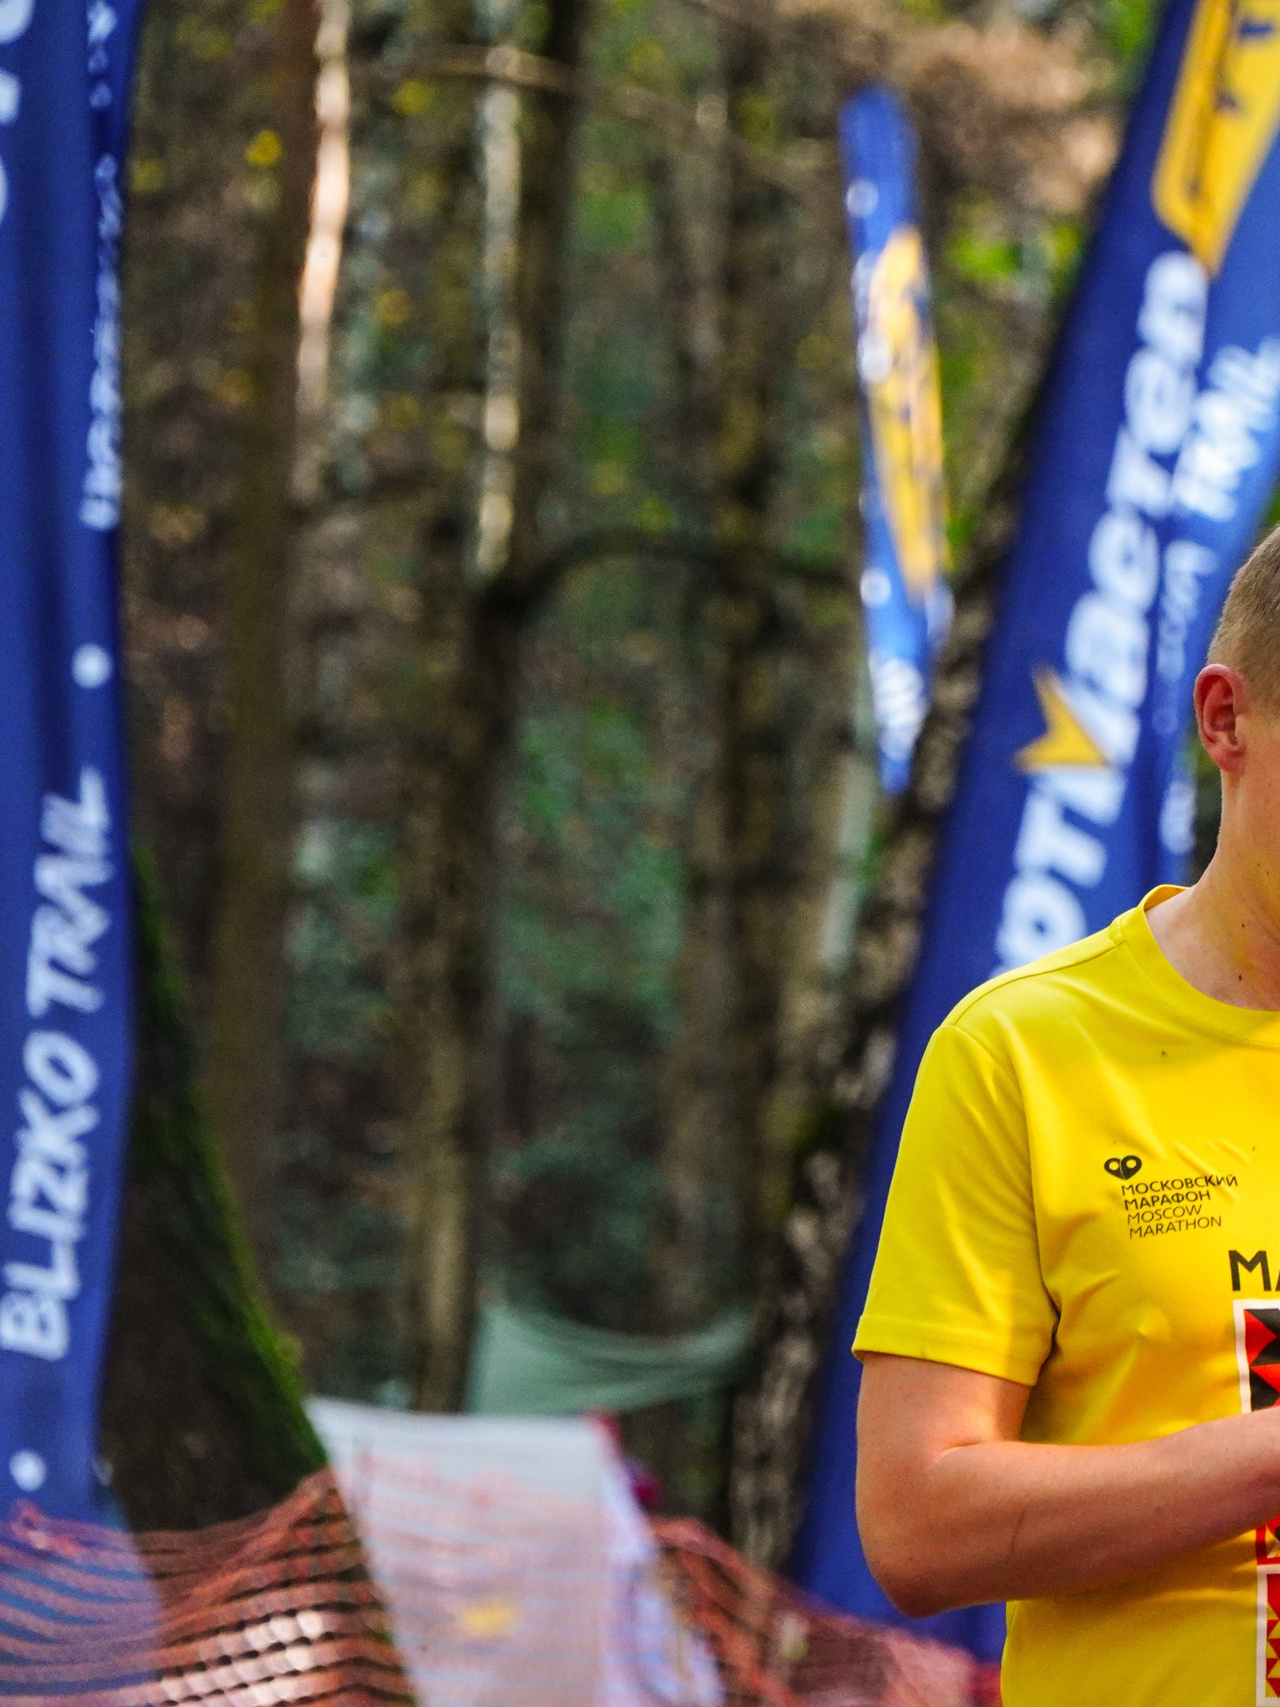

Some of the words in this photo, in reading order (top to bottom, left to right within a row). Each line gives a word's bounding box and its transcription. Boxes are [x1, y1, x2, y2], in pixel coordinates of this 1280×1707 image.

[27, 766, 114, 1016] TRAIL
[0, 1030, 98, 1361] BLIZKO
[1121, 1174, 1238, 1196] МОСКОВСКИЙ
[1124, 1190, 1211, 1211] МАРАФОН
[1127, 1204, 1203, 1225] MOSCOW
[1129, 1216, 1222, 1239] MARATHON
